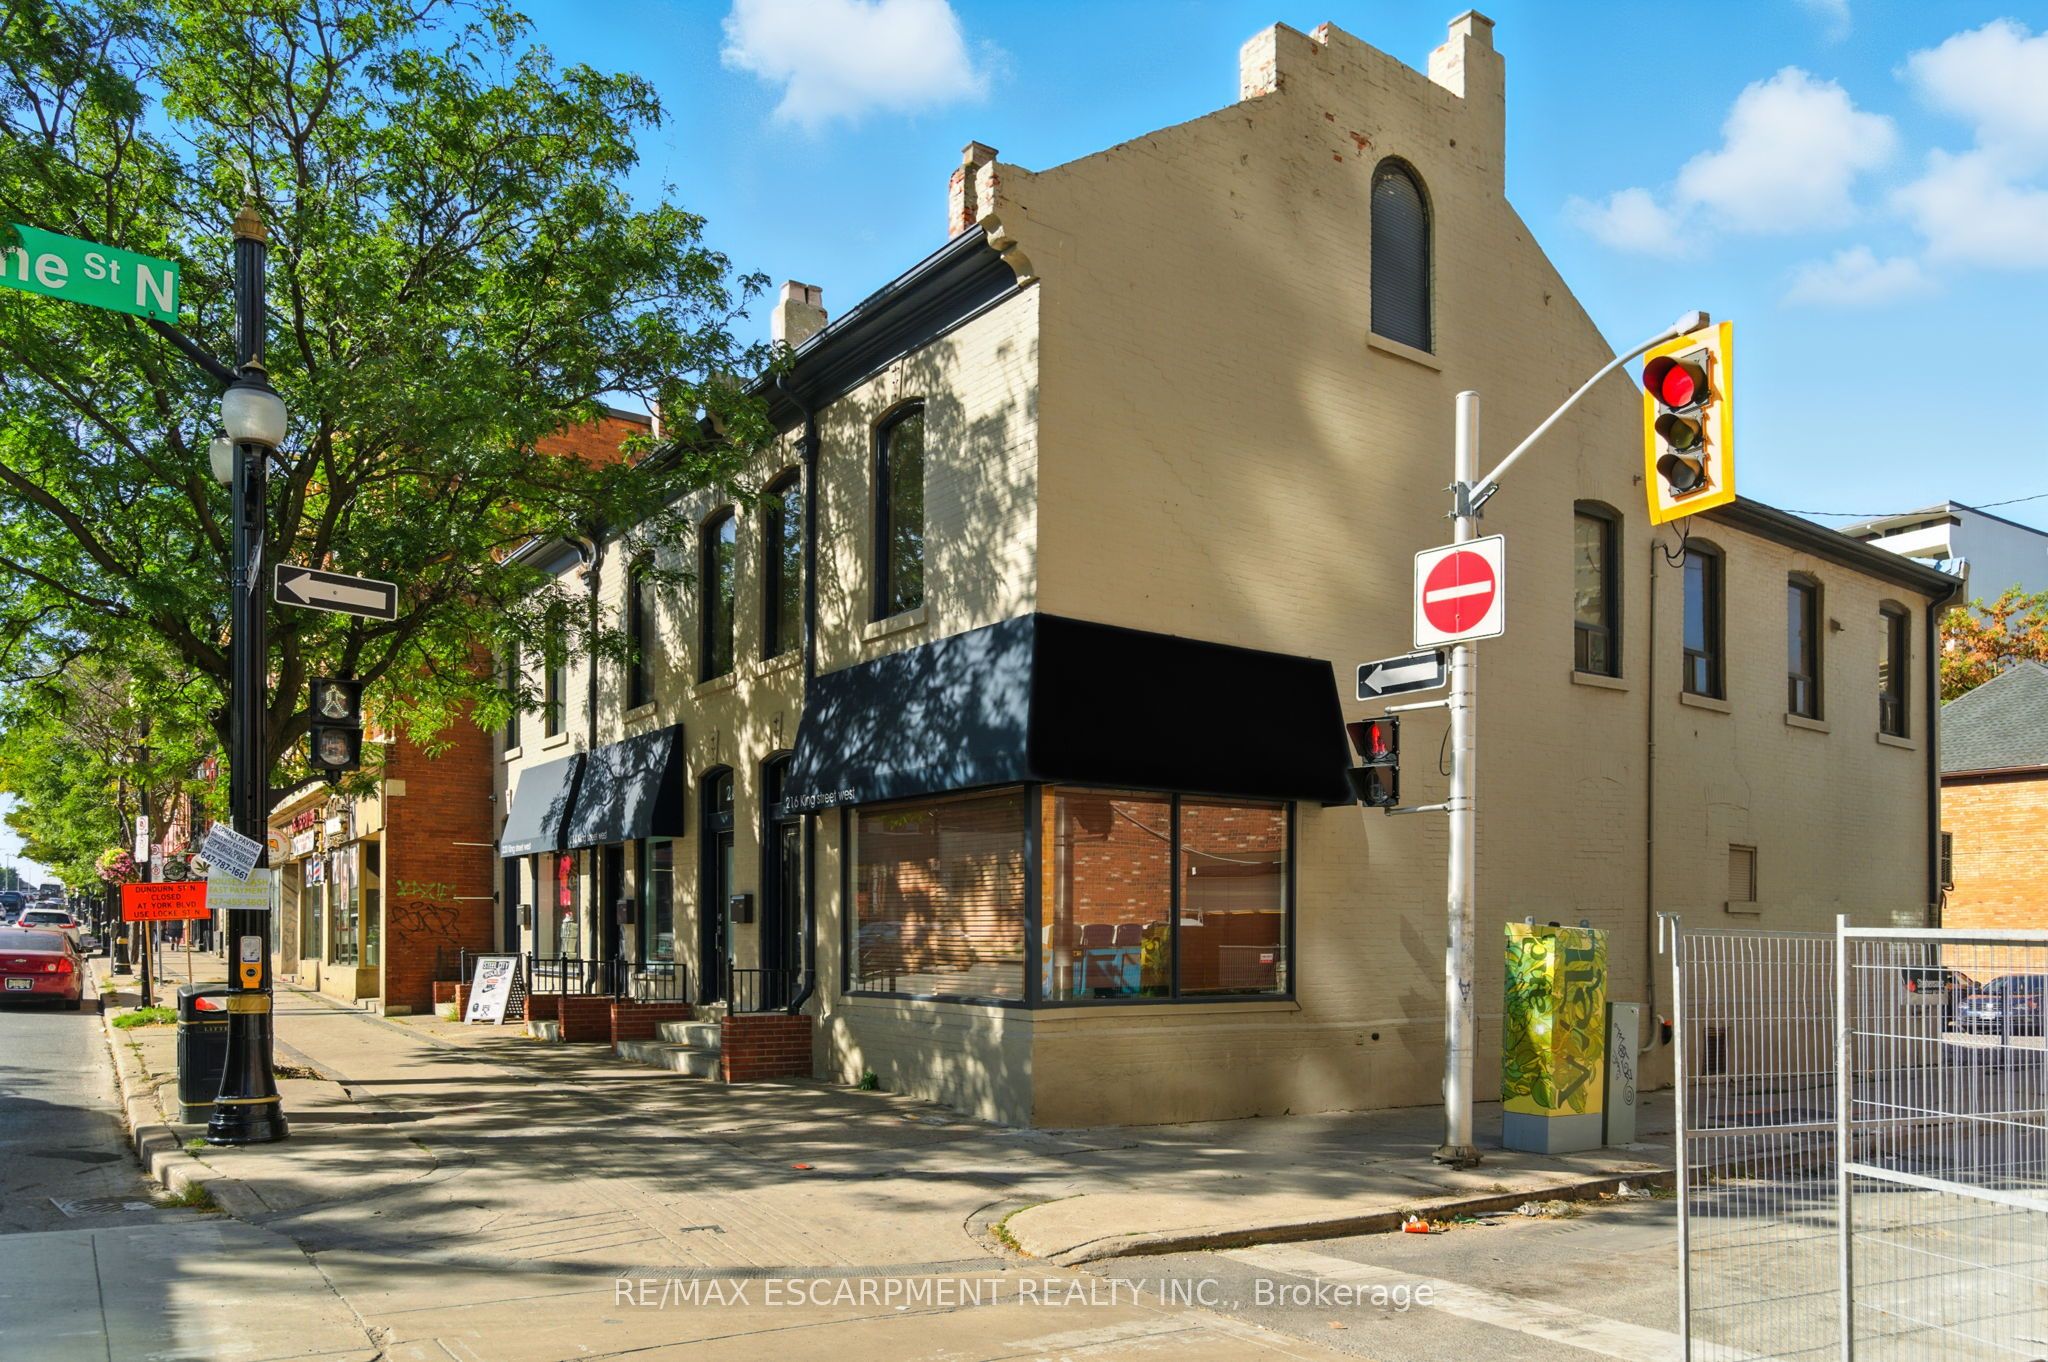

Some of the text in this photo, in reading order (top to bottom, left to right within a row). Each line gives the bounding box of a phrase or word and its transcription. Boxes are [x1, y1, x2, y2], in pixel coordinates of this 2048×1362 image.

[84, 252, 120, 285] St
[136, 264, 174, 313] N
[785, 786, 856, 809] 216 King street west
[214, 824, 238, 840] ASPHALT
[238, 836, 260, 851] PAVING
[200, 851, 248, 880] 647-787-1661
[135, 885, 174, 894] DUNDURN
[190, 884, 196, 892] N
[151, 893, 182, 901] CLOSED
[229, 886, 269, 895] PAYMENT
[137, 902, 147, 910] AT
